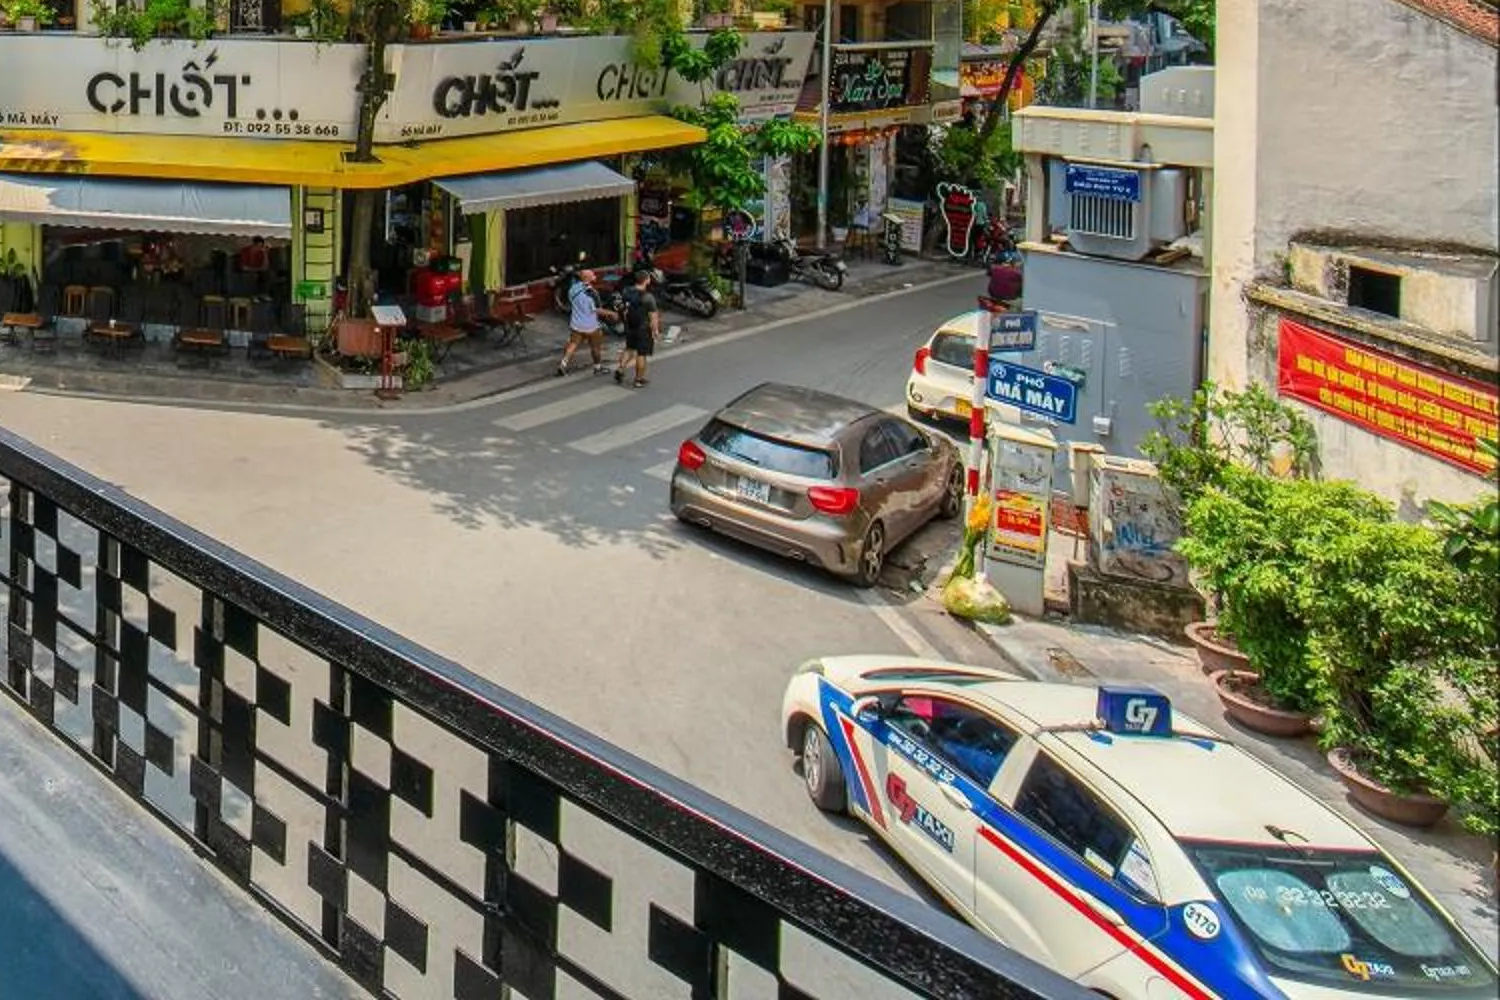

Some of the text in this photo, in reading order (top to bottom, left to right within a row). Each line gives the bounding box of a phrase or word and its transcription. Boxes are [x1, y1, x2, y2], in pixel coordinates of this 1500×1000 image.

[247, 122, 271, 133] 092
[314, 125, 339, 137] 668
[995, 379, 1065, 413] MÃ MÂY
[1016, 373, 1045, 390] PHỐ
[1125, 698, 1158, 734] G7
[886, 771, 917, 826] G7
[1185, 906, 1218, 936] 3170
